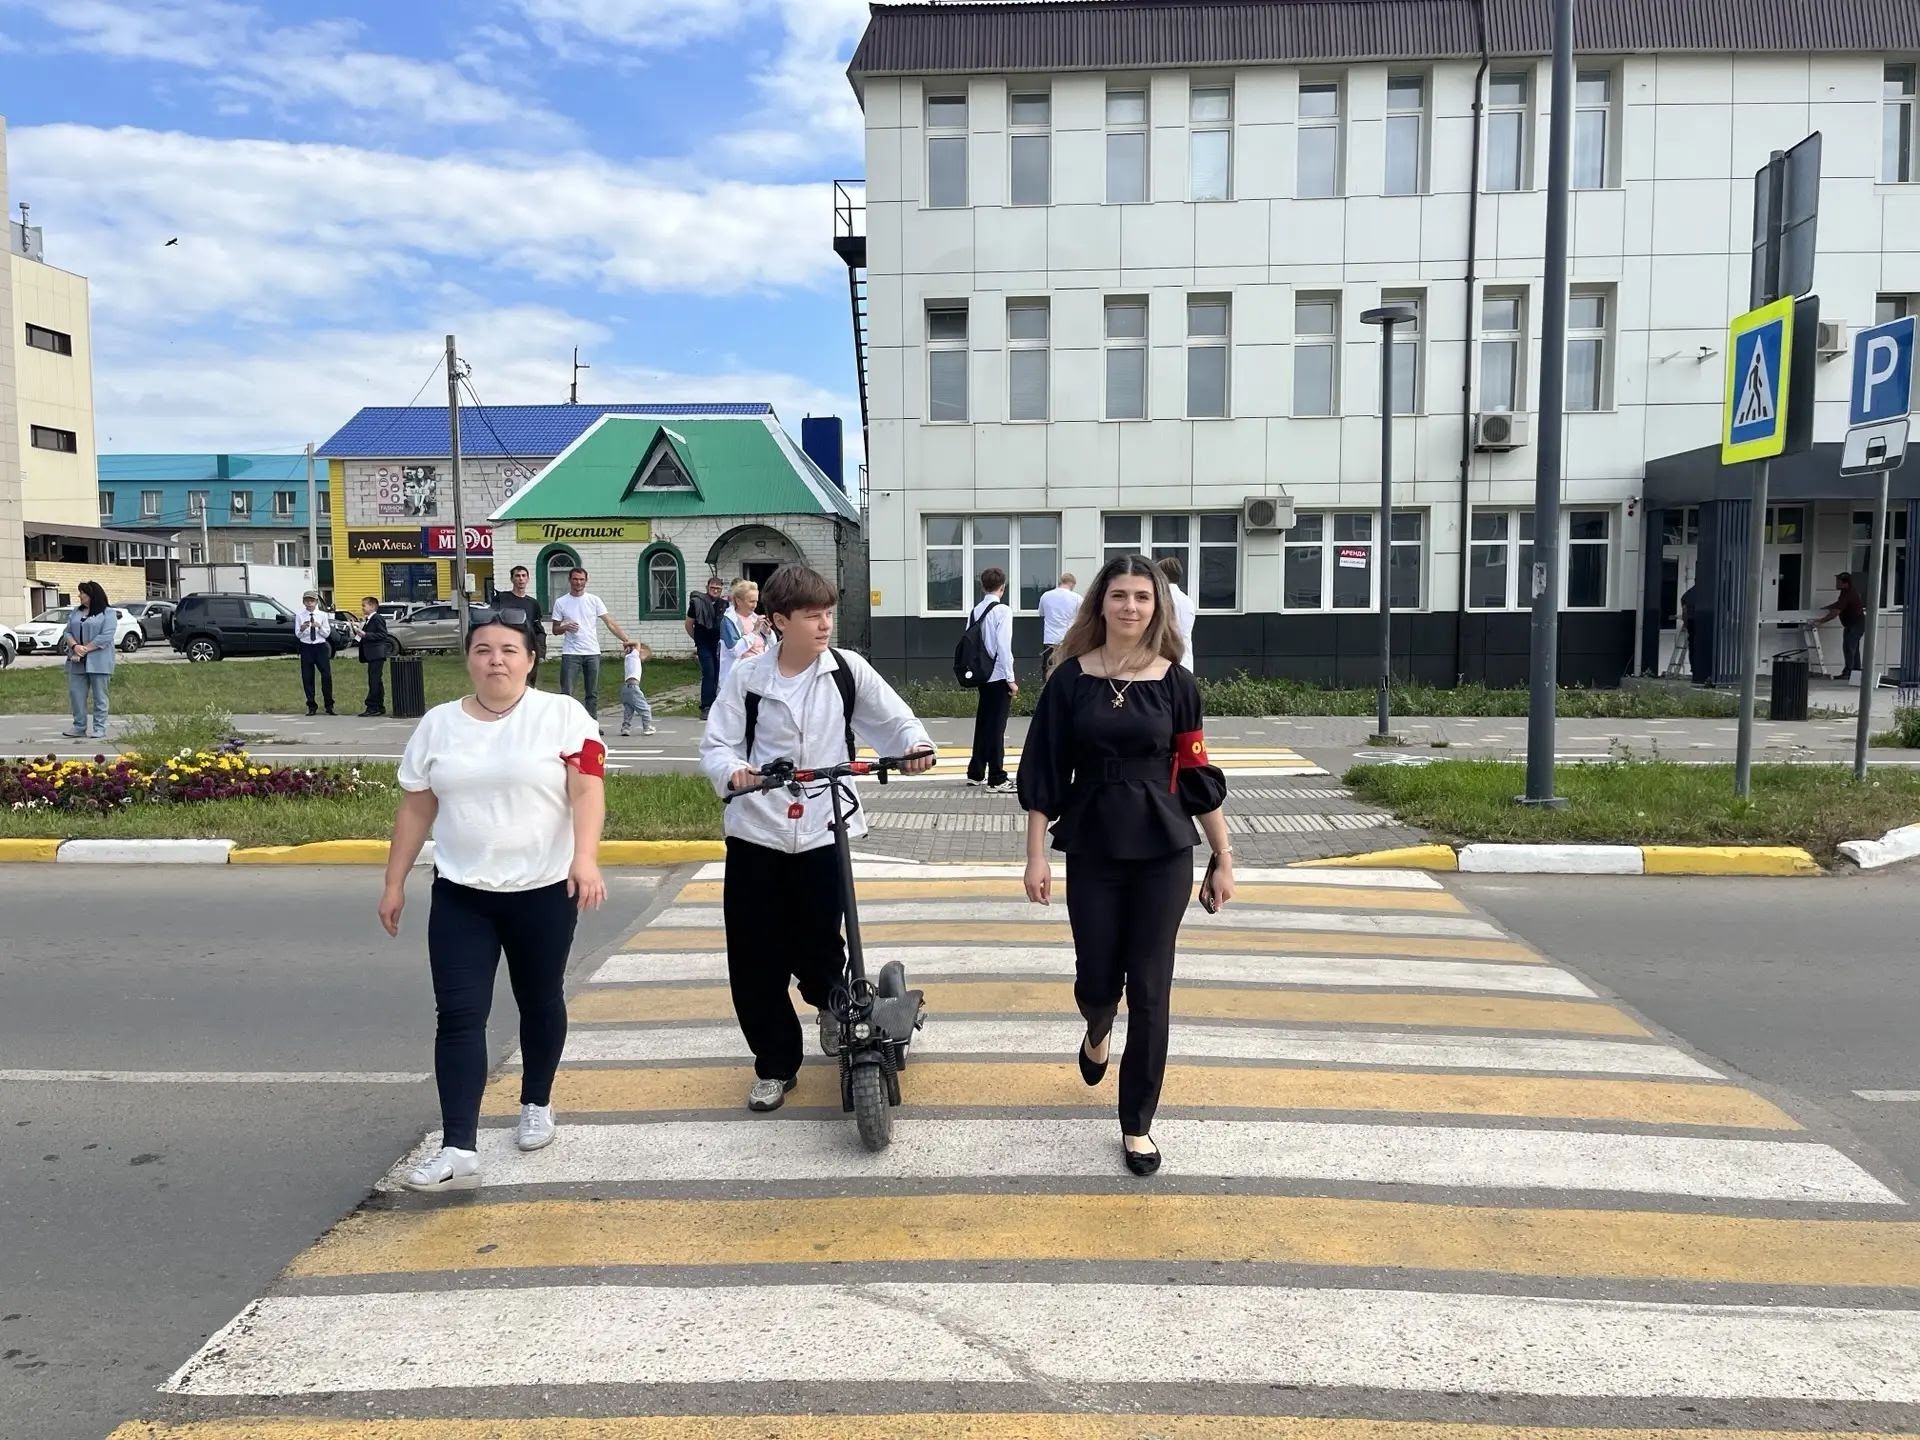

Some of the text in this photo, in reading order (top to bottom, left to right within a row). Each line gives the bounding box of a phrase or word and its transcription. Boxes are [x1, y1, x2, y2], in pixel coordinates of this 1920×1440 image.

[1863, 335, 1899, 413] P
[542, 524, 625, 541] Престиж
[1341, 549, 1366, 557] АРЕНДА
